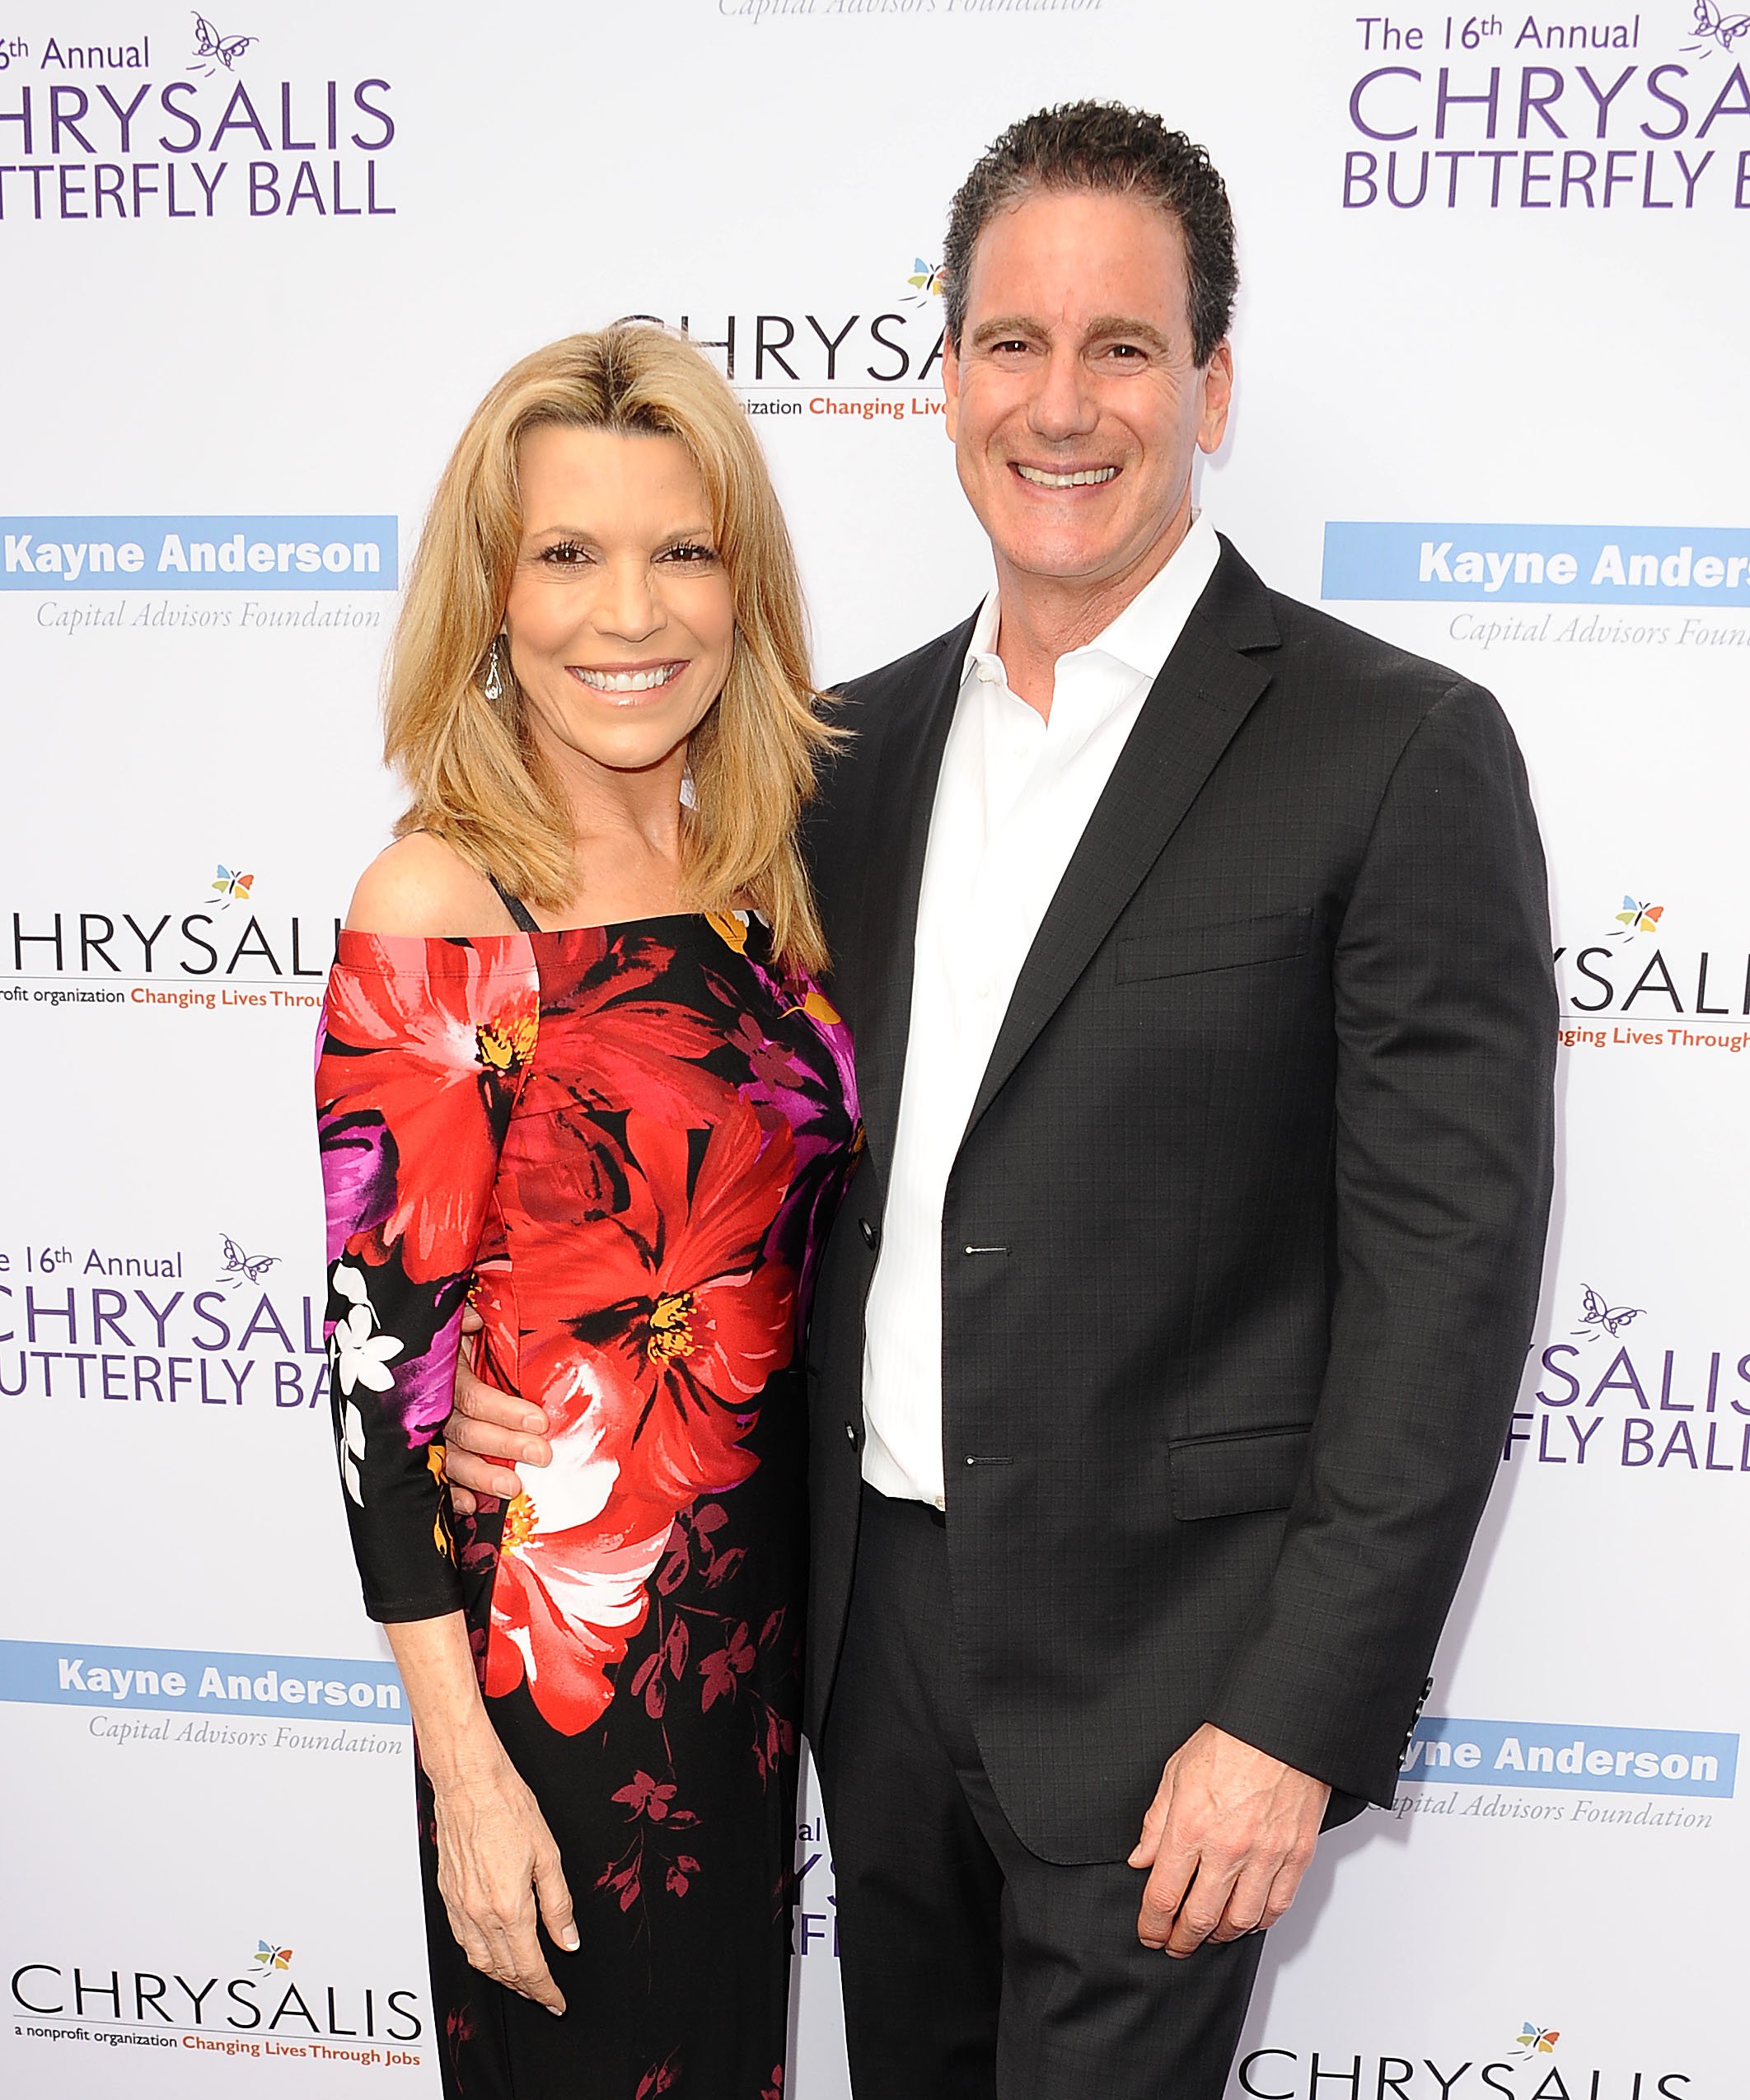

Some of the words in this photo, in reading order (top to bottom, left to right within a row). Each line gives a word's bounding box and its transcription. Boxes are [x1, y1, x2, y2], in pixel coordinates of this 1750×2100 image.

[1355, 16, 1424, 51] The
[1444, 13, 1503, 50] 16th
[1514, 14, 1640, 49] Annual
[40, 35, 149, 70] Annual
[249, 159, 396, 217] BALL
[1342, 149, 1716, 209] BUTTERFLY
[809, 397, 905, 420] Changing
[4, 535, 145, 581] Kayne
[157, 534, 380, 573] Anderson
[1419, 541, 1578, 592] Kayne
[36, 600, 126, 636] Capital
[130, 599, 232, 627] Advisors
[240, 600, 380, 628] Foundation
[1449, 613, 1552, 650] Capital
[1557, 614, 1670, 644] Advisors
[33, 988, 125, 1007] organization
[130, 987, 216, 1010] Changing
[222, 989, 267, 1007] Lives
[1612, 1027, 1663, 1045] Lives
[26, 1246, 73, 1274] 16th
[82, 1248, 182, 1279] Annual
[58, 1658, 186, 1700] Kayne
[198, 1664, 401, 1709] Anderson
[89, 1715, 171, 1746] Capital
[175, 1720, 268, 1747] Advisors
[274, 1726, 404, 1755] Foundation
[1493, 1738, 1719, 1781] Anderson
[1459, 1788, 1566, 1821] Advisors
[1569, 1796, 1715, 1829] Foundation
[11, 1964, 423, 2042] CHRYSALIS
[14, 2026, 23, 2036] a
[26, 2027, 91, 2042] nonprofit
[94, 2032, 178, 2047] organization
[182, 2036, 260, 2057] Changing
[265, 2042, 306, 2058] Lives
[309, 2045, 381, 2066] Through
[385, 2050, 420, 2066] Jobs
